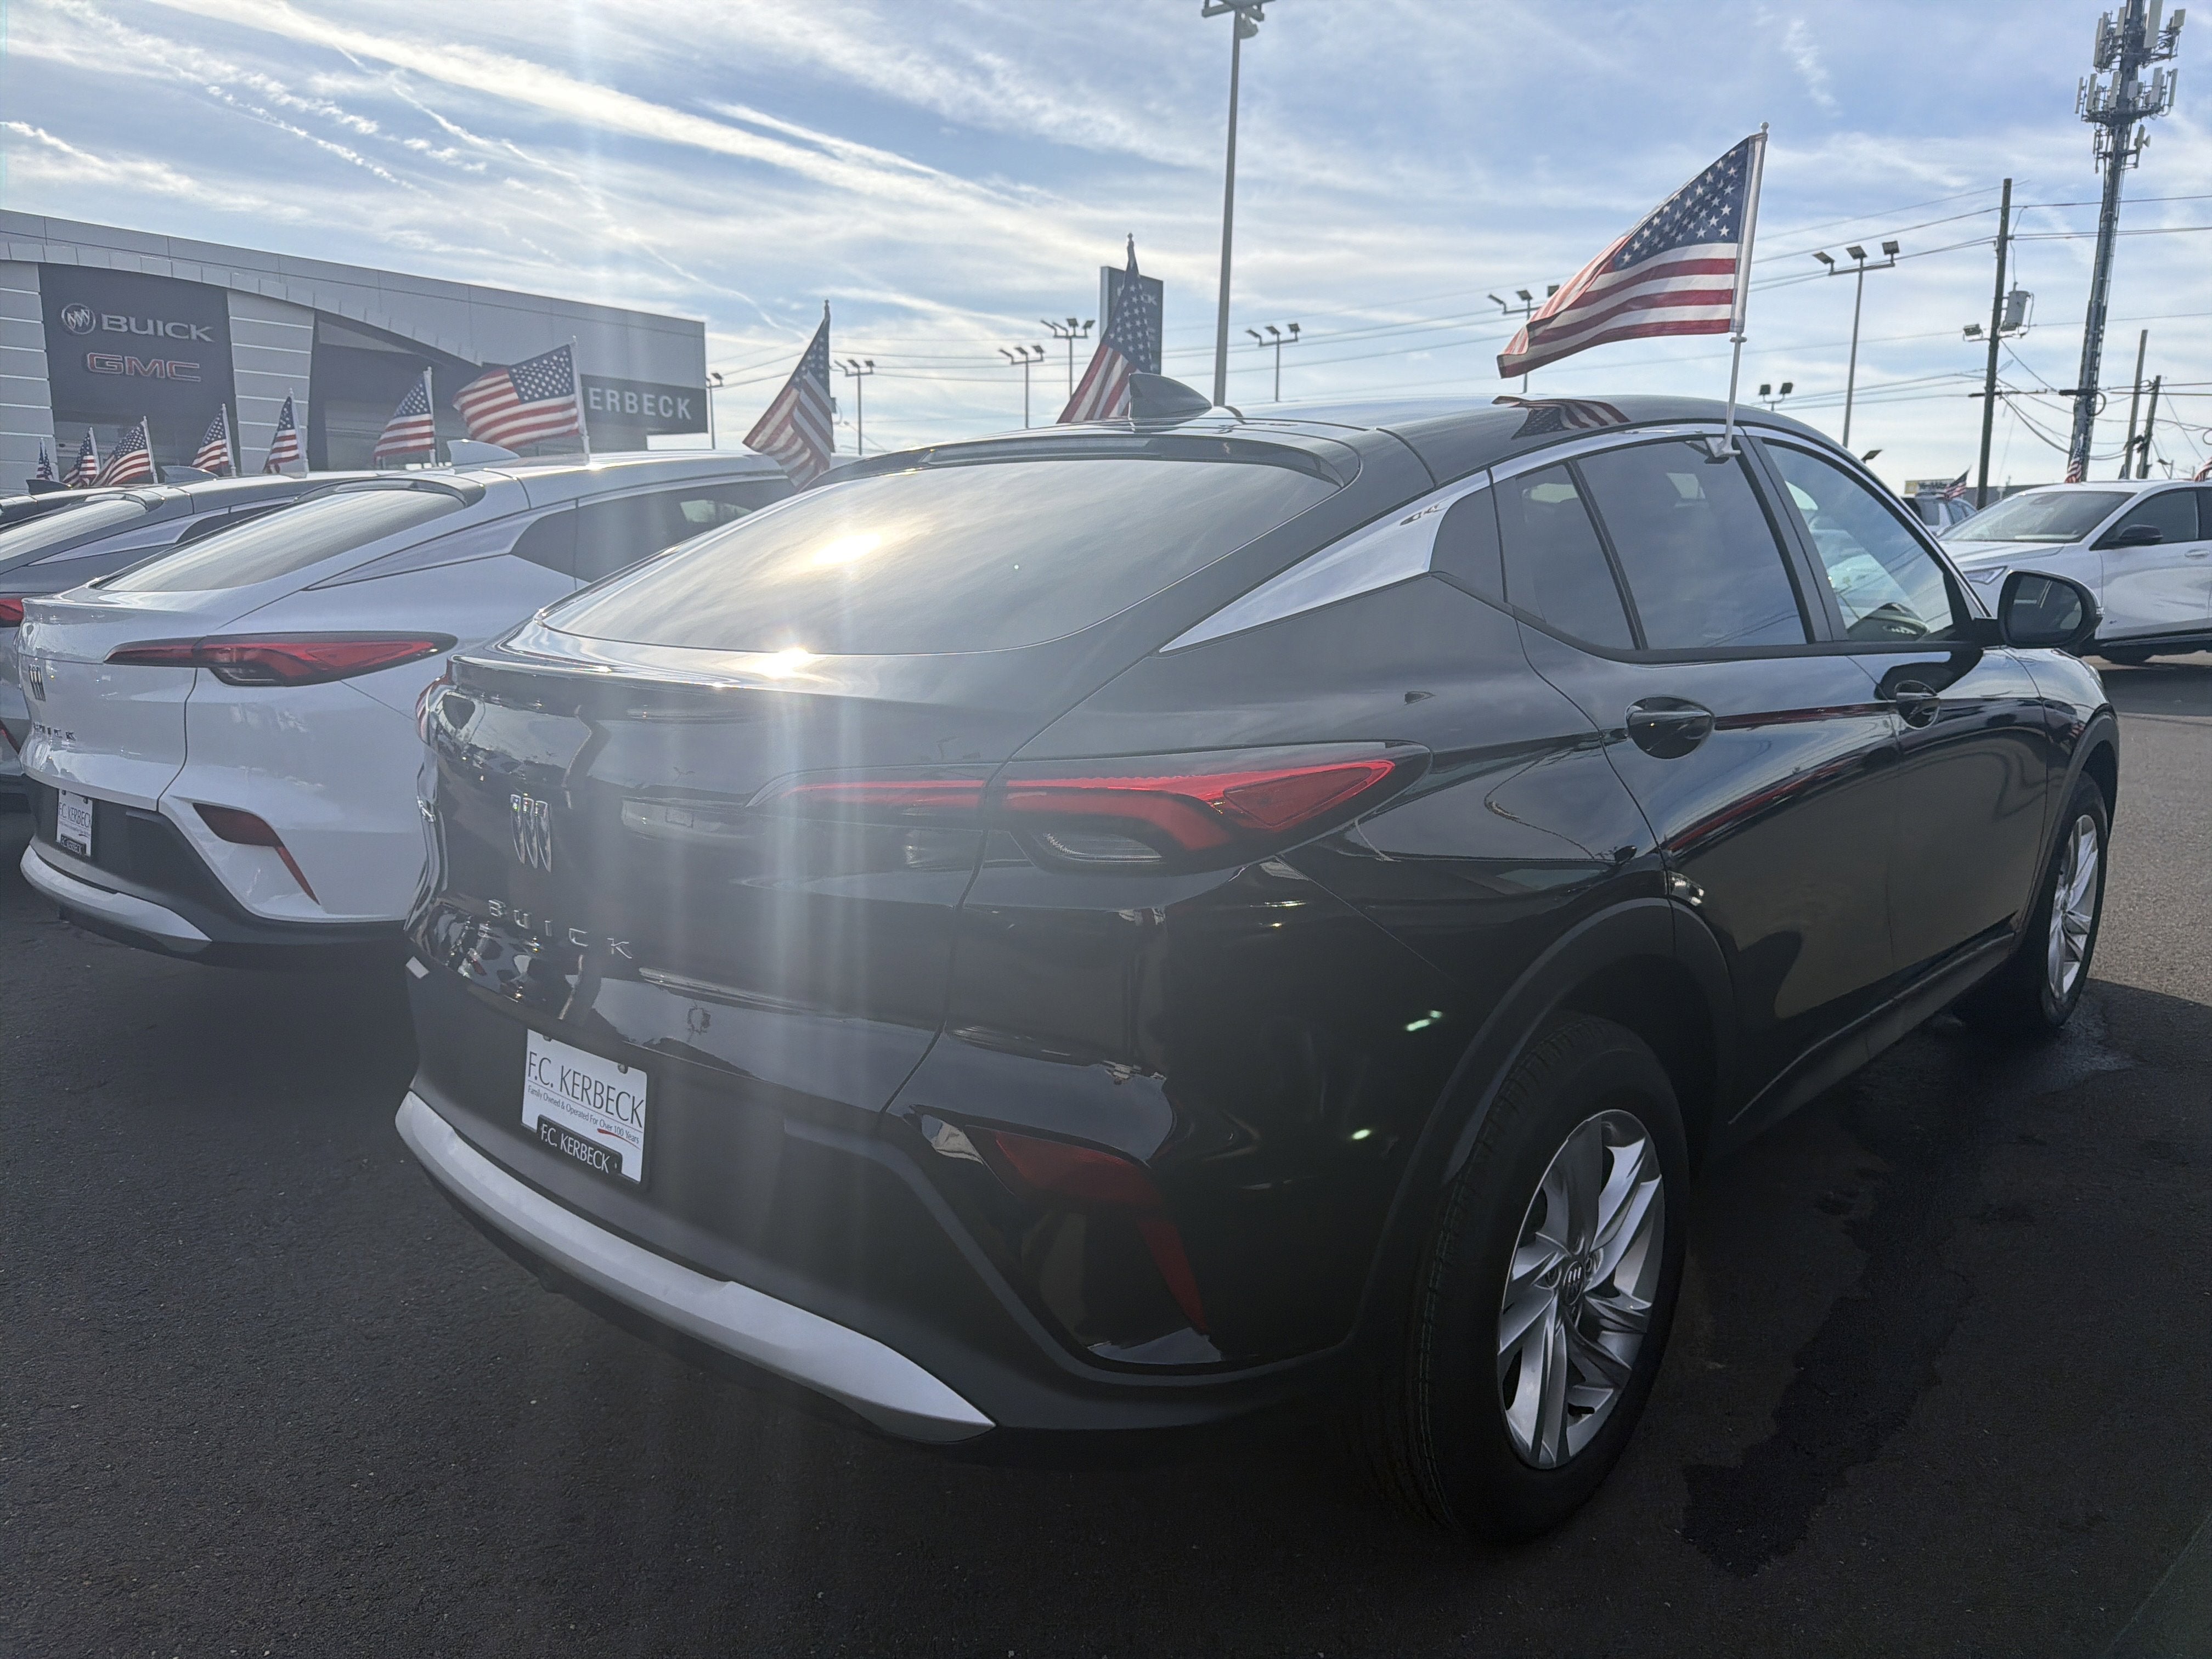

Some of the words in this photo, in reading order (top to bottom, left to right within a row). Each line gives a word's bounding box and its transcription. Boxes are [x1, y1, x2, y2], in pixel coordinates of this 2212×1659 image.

[100, 313, 215, 343] BUICK
[87, 352, 201, 382] GMC
[580, 386, 692, 420] ERBECK
[488, 899, 633, 959] BUICK
[527, 1051, 554, 1088] F.C.
[560, 1065, 645, 1128] KERBECK
[528, 1085, 543, 1100] Family
[543, 1092, 561, 1108] Owned
[561, 1101, 566, 1110] &
[566, 1103, 590, 1121] Operated
[590, 1114, 599, 1125] For
[599, 1119, 613, 1132] Over
[614, 1125, 624, 1137] 100
[625, 1130, 640, 1144] Years
[540, 1123, 557, 1148] F.C.
[560, 1132, 611, 1174] KERBECK
